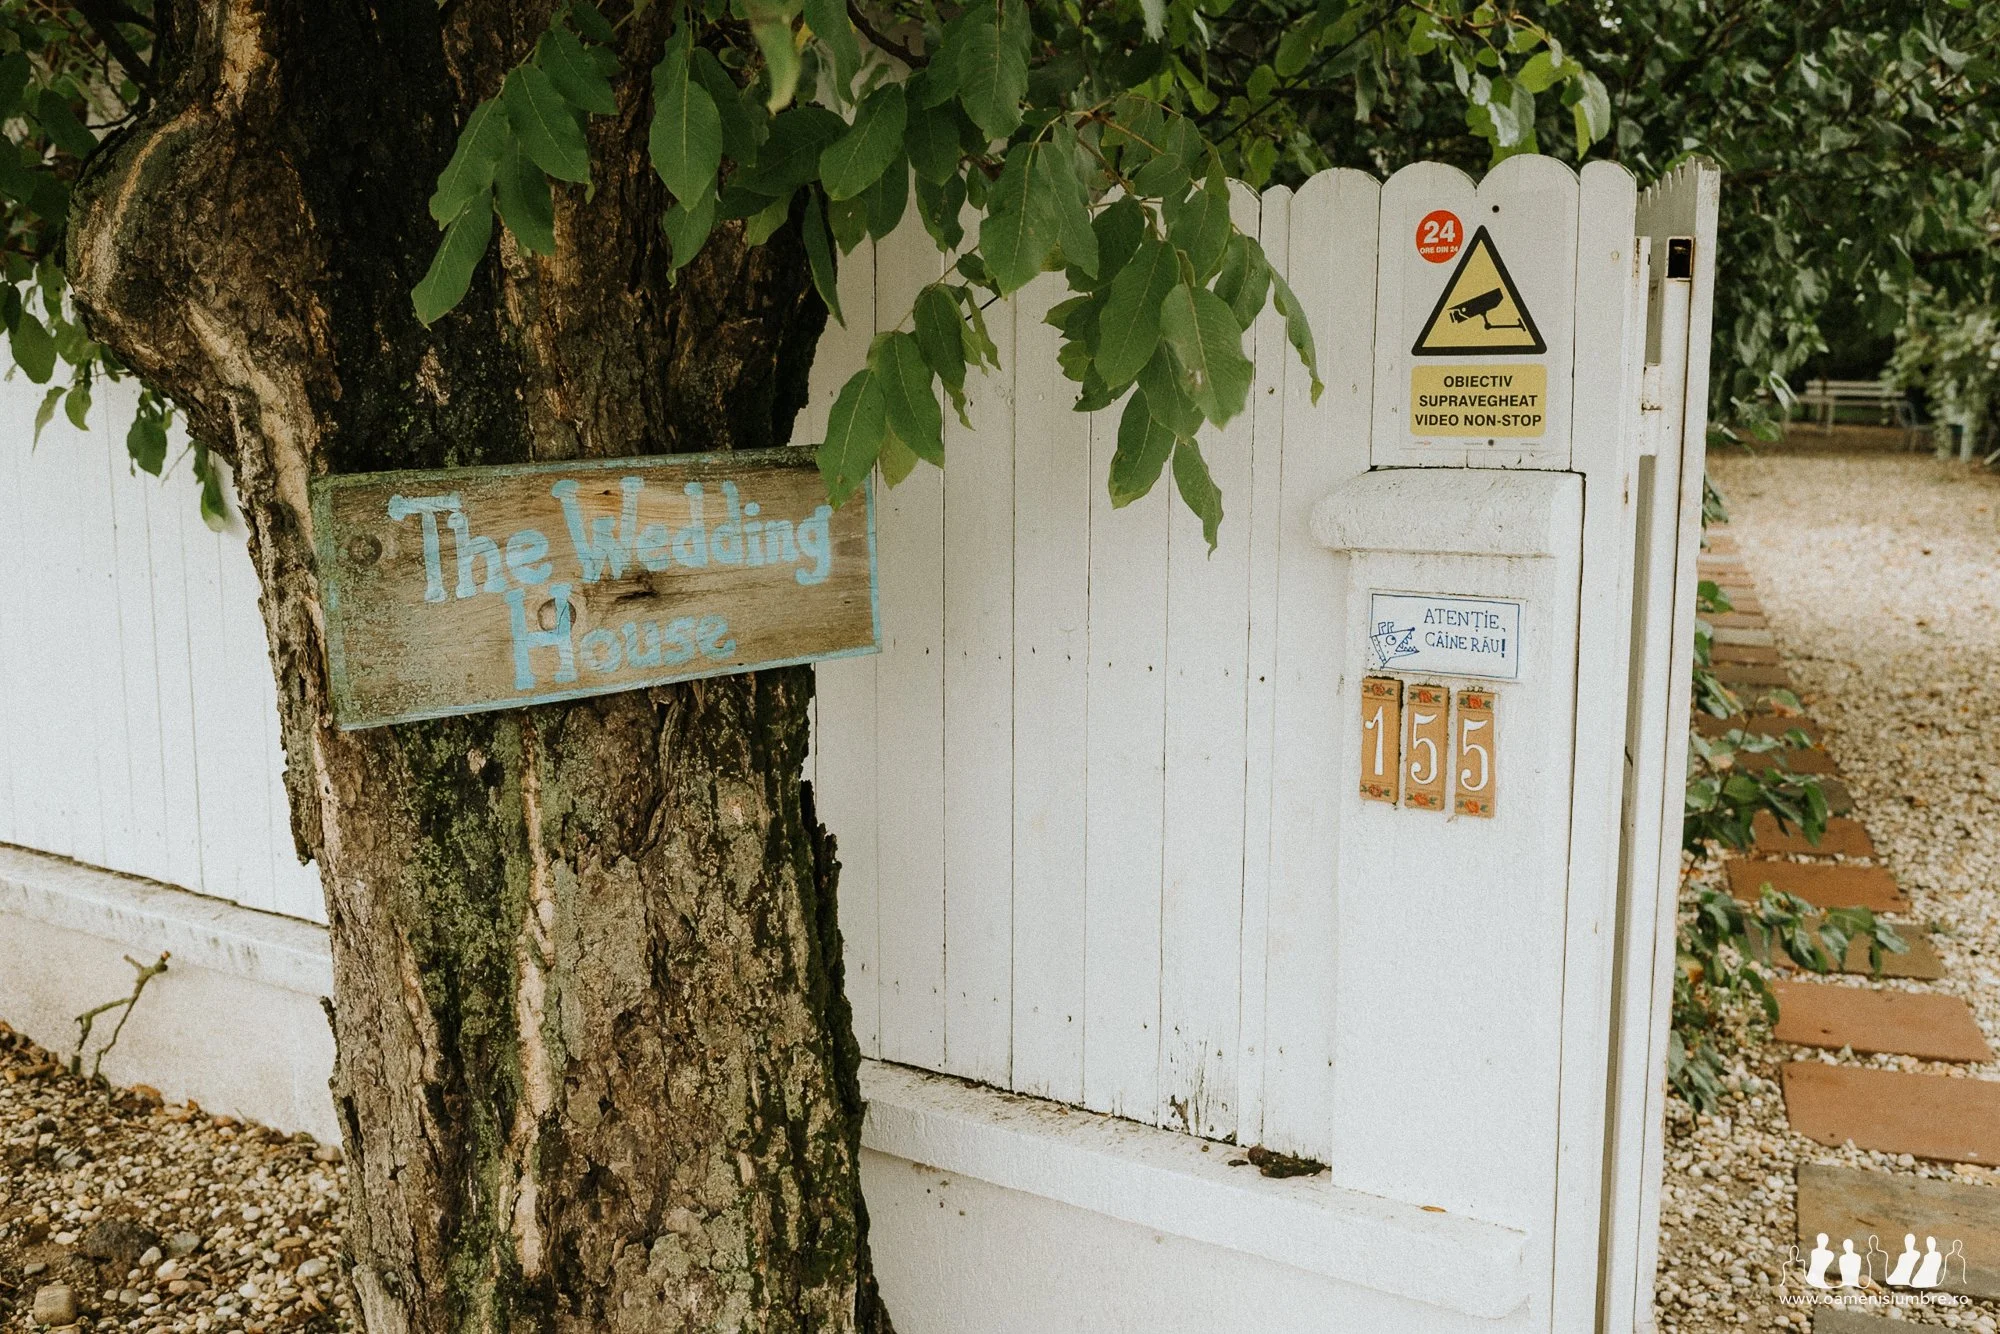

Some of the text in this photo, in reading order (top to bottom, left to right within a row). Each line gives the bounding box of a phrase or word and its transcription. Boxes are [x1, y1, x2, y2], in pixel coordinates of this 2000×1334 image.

[1424, 219, 1456, 244] 24
[1419, 245, 1459, 255] ORE DIN 24
[1443, 375, 1513, 388] OBIECTIV
[1419, 394, 1538, 408] SUPRAVEGHEAT
[1415, 414, 1542, 427] VIDEO NON-STOP
[388, 476, 834, 603] The Wedding
[506, 583, 736, 690] House
